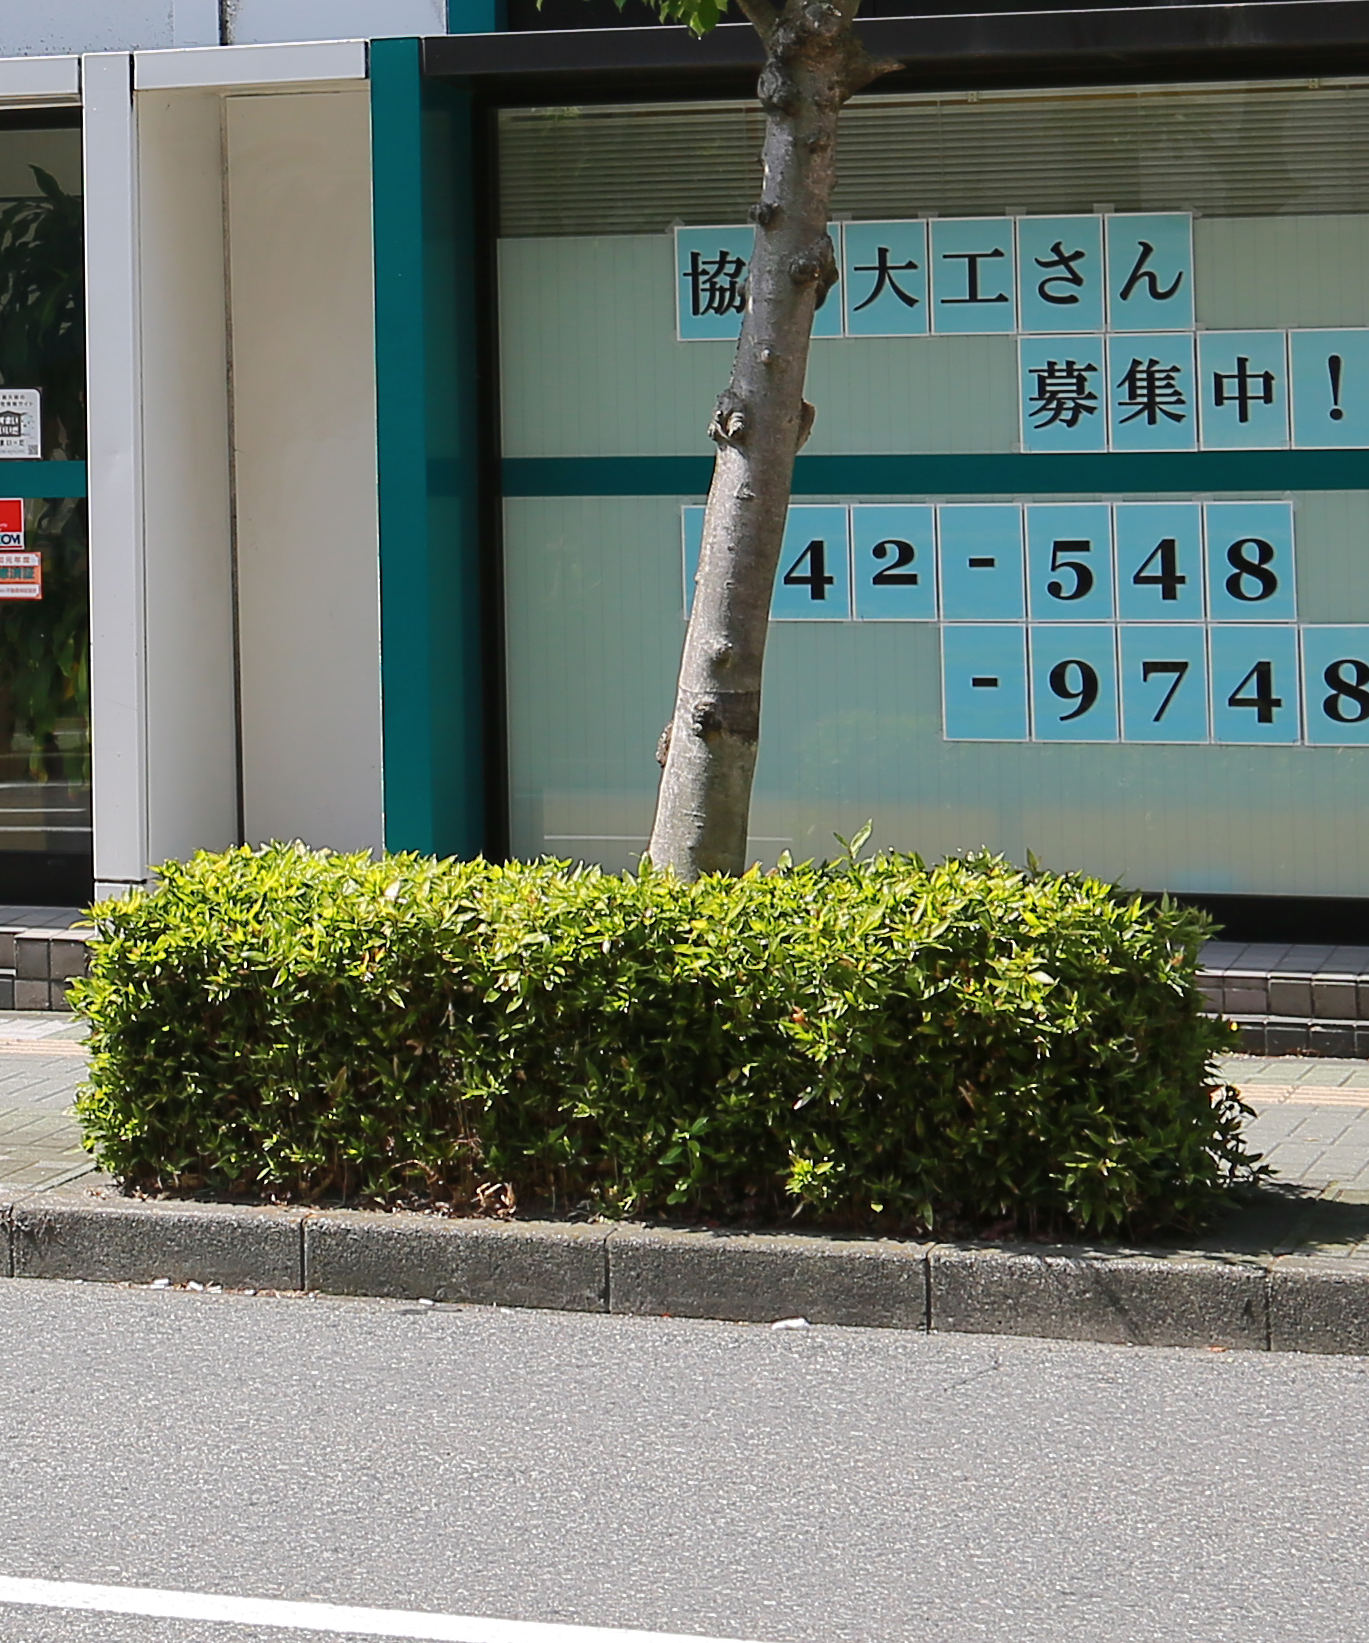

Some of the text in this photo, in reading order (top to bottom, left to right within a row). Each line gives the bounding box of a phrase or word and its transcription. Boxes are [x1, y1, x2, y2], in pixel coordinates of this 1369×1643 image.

[683, 241, 1184, 316] 協大工さん
[1028, 355, 1343, 430] 募集中!
[783, 539, 1278, 602] 42-548
[972, 658, 1369, 724] -9748
